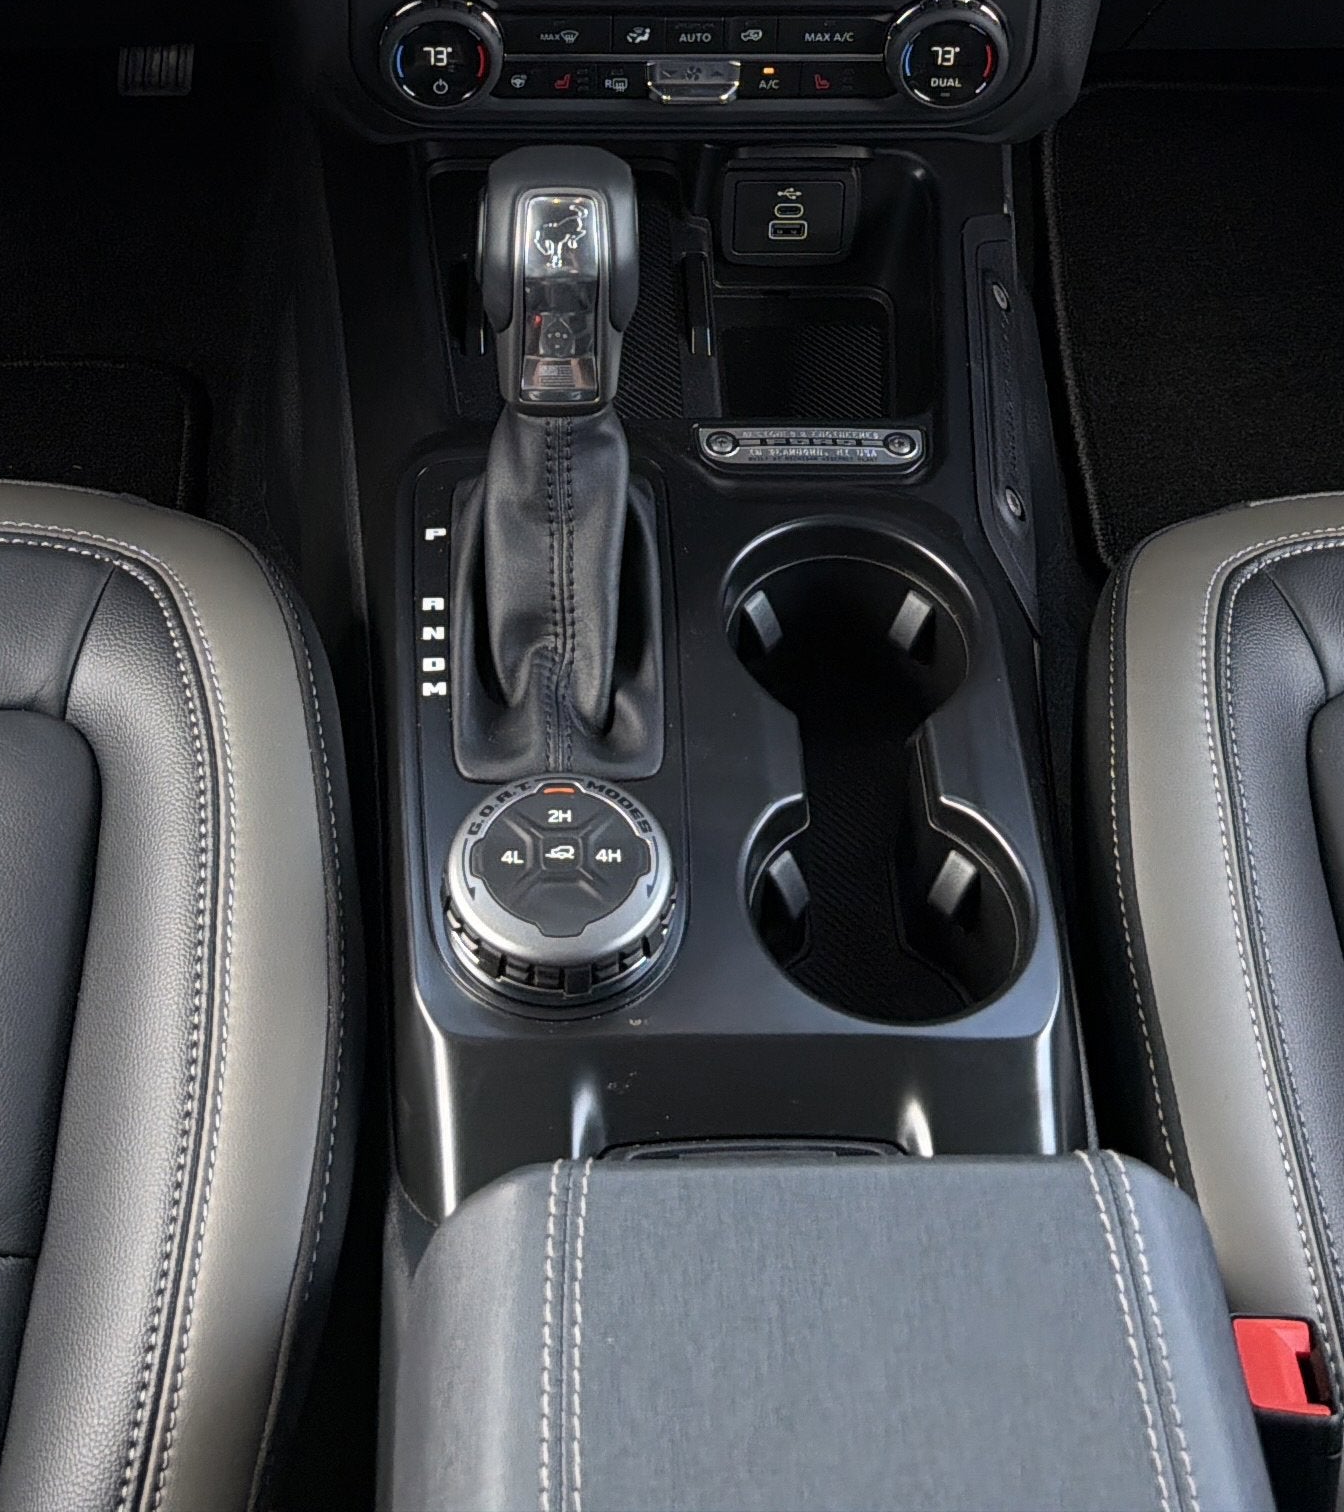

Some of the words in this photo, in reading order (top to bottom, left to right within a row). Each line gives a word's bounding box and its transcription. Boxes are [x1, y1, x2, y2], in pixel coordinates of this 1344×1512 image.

[540, 33, 561, 42] MAX
[679, 33, 712, 44] AUTO
[805, 32, 831, 43] MAX
[834, 32, 854, 43] A/C
[759, 79, 780, 90] A/C
[931, 77, 962, 88] DUAL
[425, 528, 447, 541] P
[422, 627, 445, 640] N
[422, 658, 446, 672] D
[422, 682, 447, 696] M
[587, 780, 653, 834] MODES
[548, 809, 572, 823] 2H
[501, 850, 524, 865] 4L
[595, 849, 622, 863] 4H
